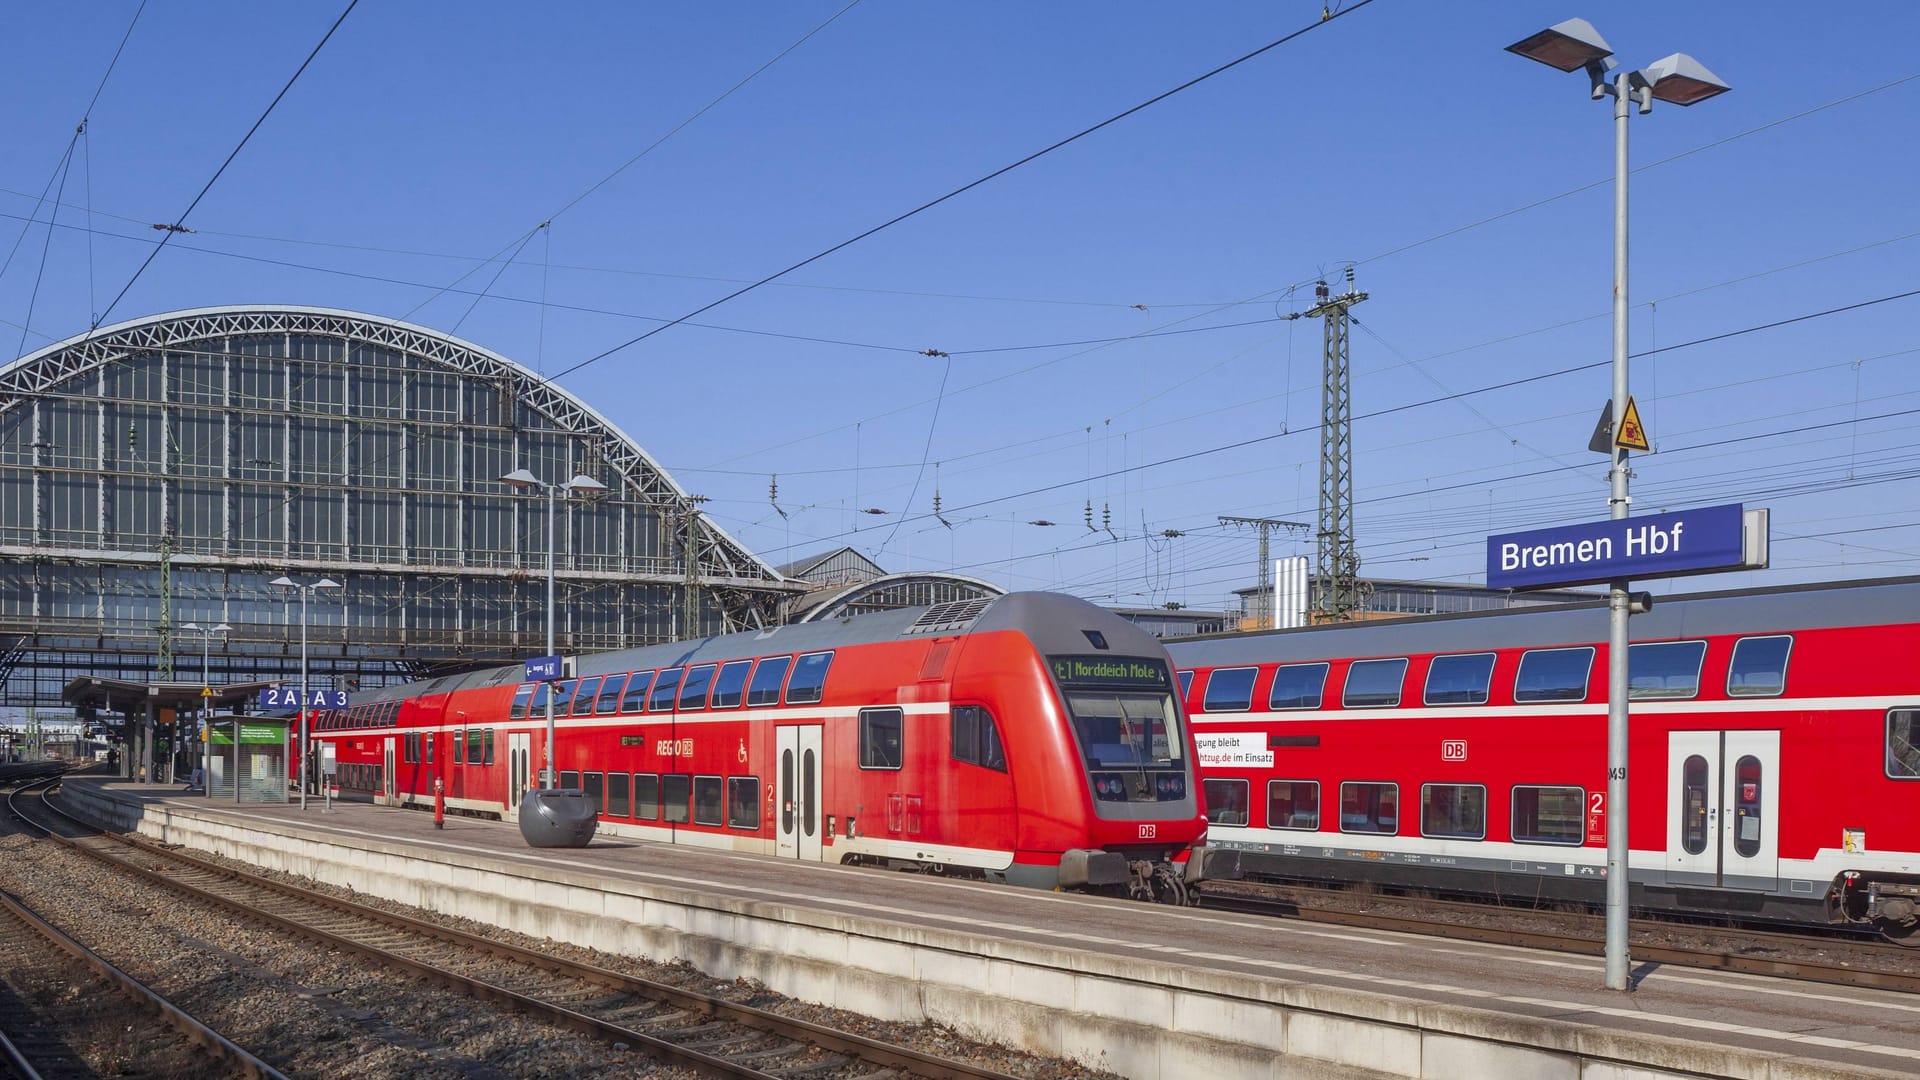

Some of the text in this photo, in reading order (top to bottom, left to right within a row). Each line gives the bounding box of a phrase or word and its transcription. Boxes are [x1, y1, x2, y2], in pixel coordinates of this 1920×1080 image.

[1502, 521, 1683, 571] Bremen Hbf
[1075, 662, 1128, 678] Norddeich
[1130, 662, 1155, 679] Mole
[267, 689, 347, 706] 2 A A 3
[1218, 737, 1240, 747] bleibt
[1444, 742, 1465, 759] DB
[1233, 753, 1244, 763] im
[1245, 752, 1273, 763] Einsatz
[767, 785, 774, 802] 2
[1591, 793, 1603, 814] 2
[1139, 825, 1155, 838] DB
